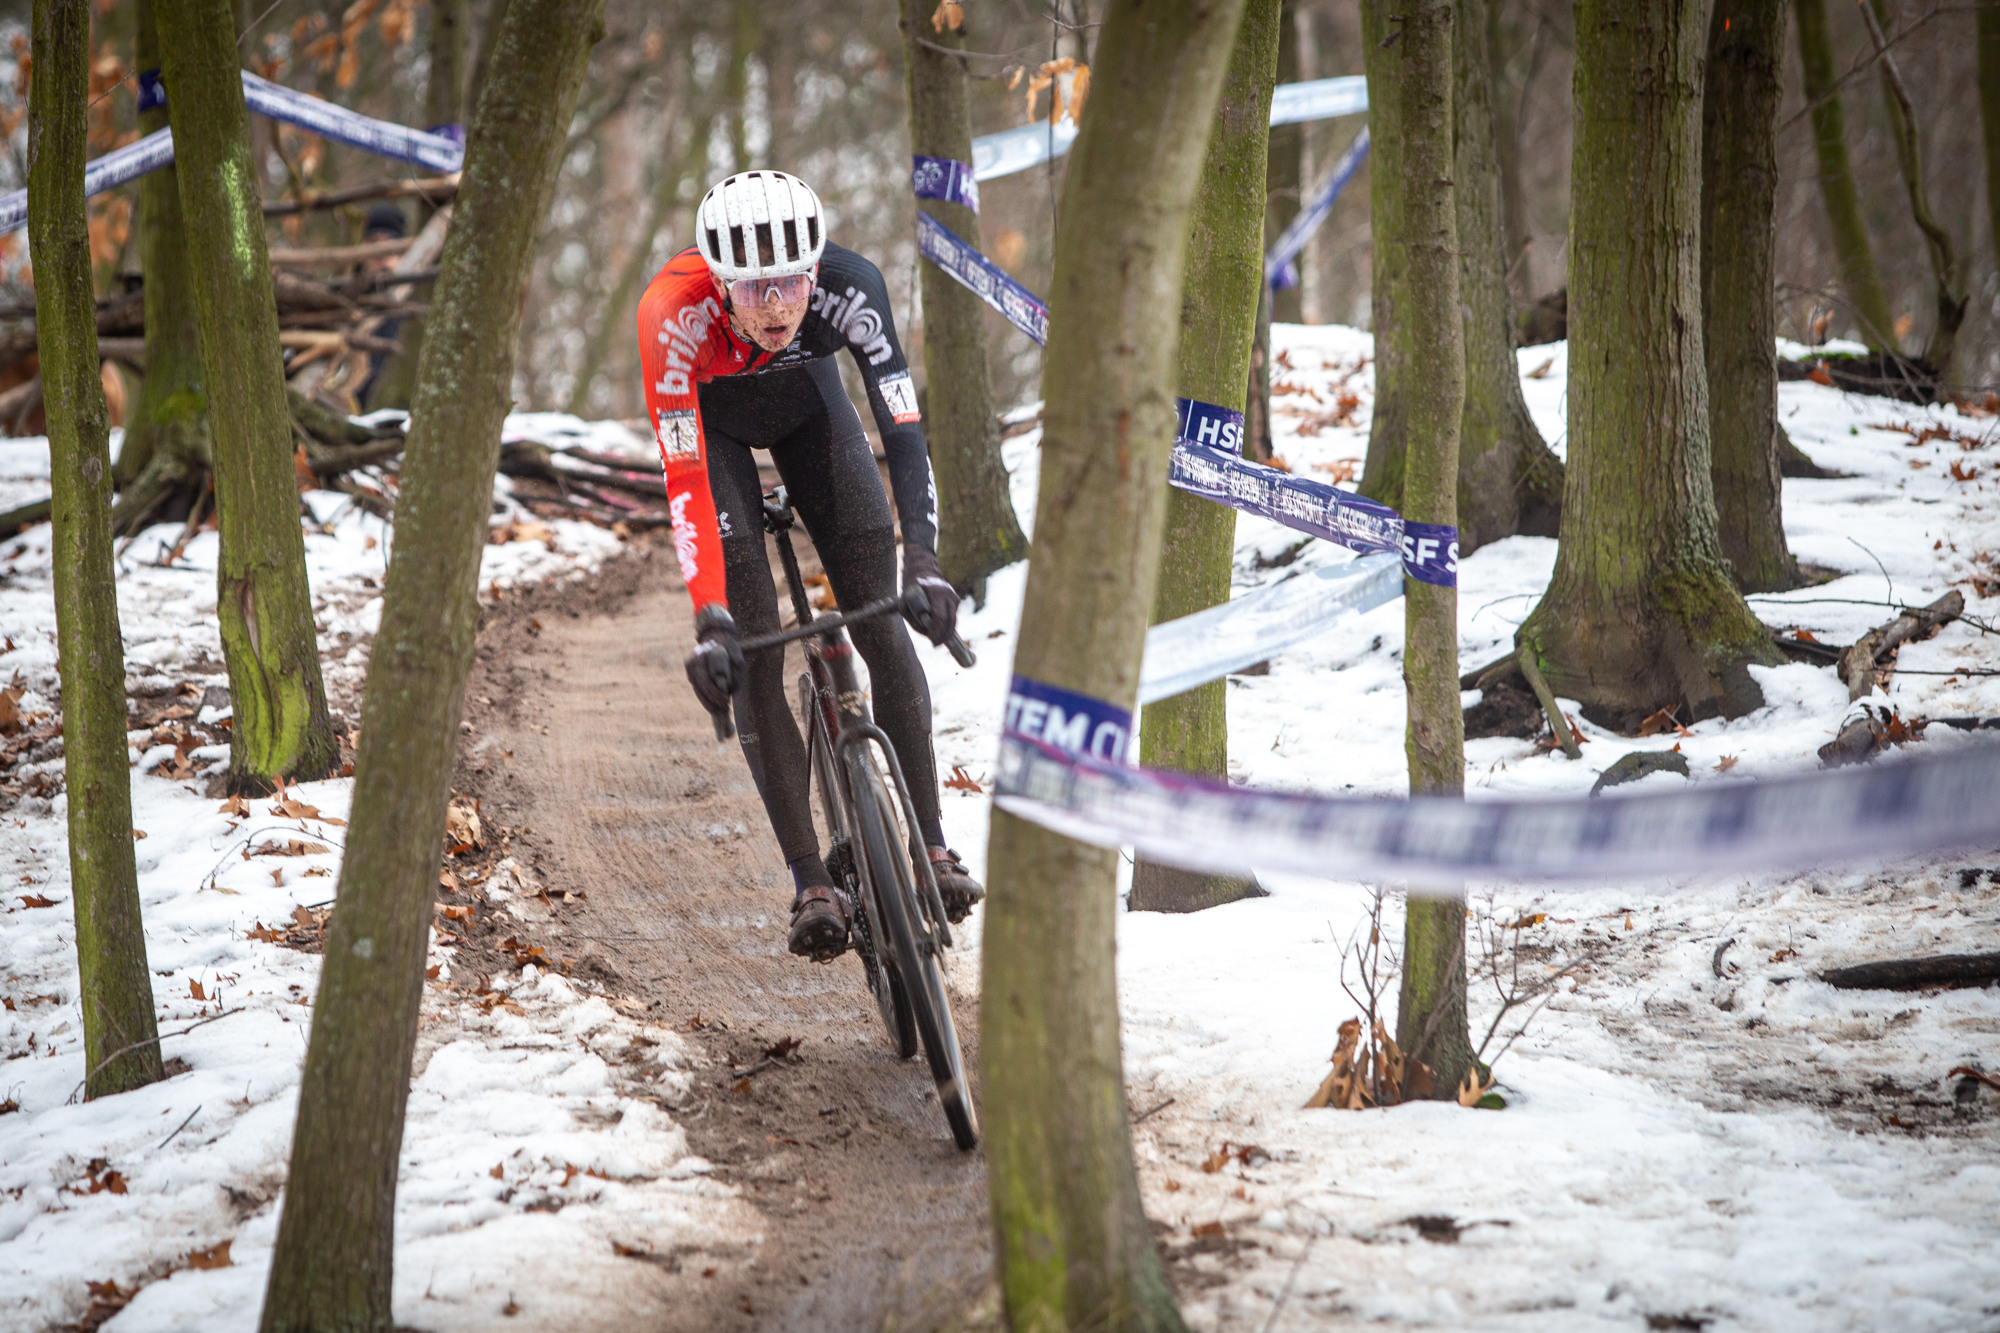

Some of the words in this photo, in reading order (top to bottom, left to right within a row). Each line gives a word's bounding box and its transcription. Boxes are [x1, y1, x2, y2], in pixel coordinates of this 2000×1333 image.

[655, 295, 722, 396] brilon
[894, 383, 909, 411] 1
[671, 420, 682, 451] 1
